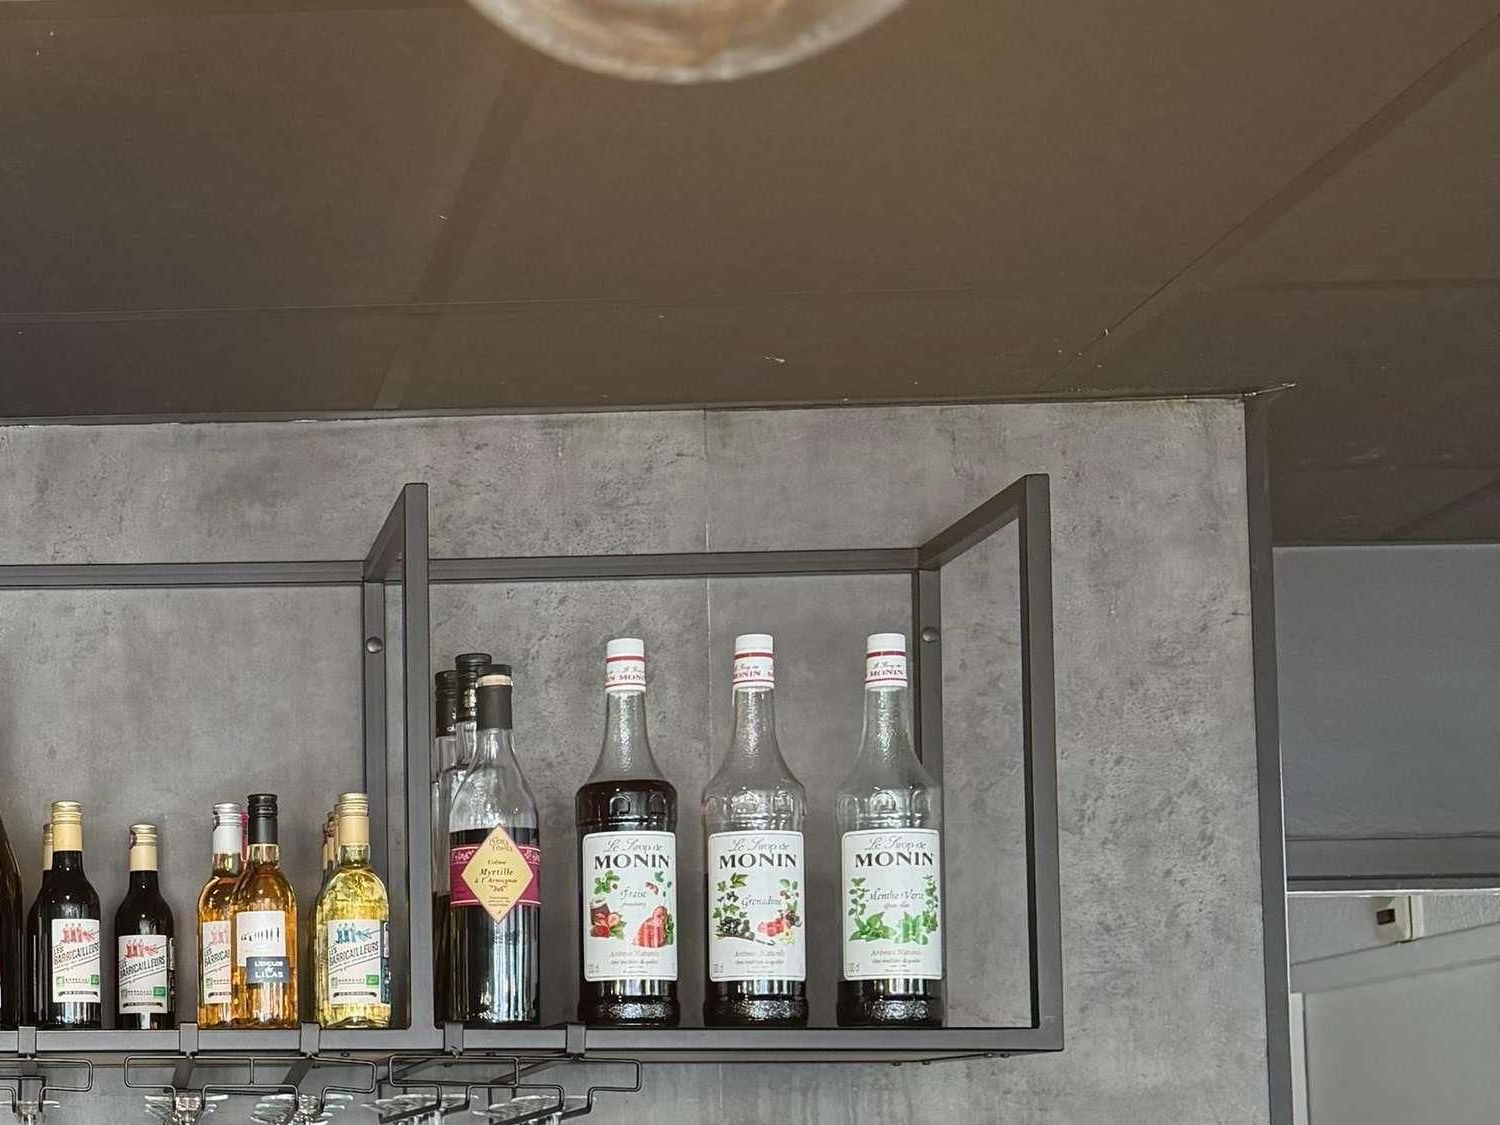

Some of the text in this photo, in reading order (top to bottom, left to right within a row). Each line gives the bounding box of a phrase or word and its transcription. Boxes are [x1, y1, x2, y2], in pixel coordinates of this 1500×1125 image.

[594, 853, 670, 870] MONIN
[719, 853, 797, 870] MONIN
[855, 851, 934, 868] MONIN
[480, 867, 514, 879] Myrtille
[255, 971, 284, 979] LILAS
